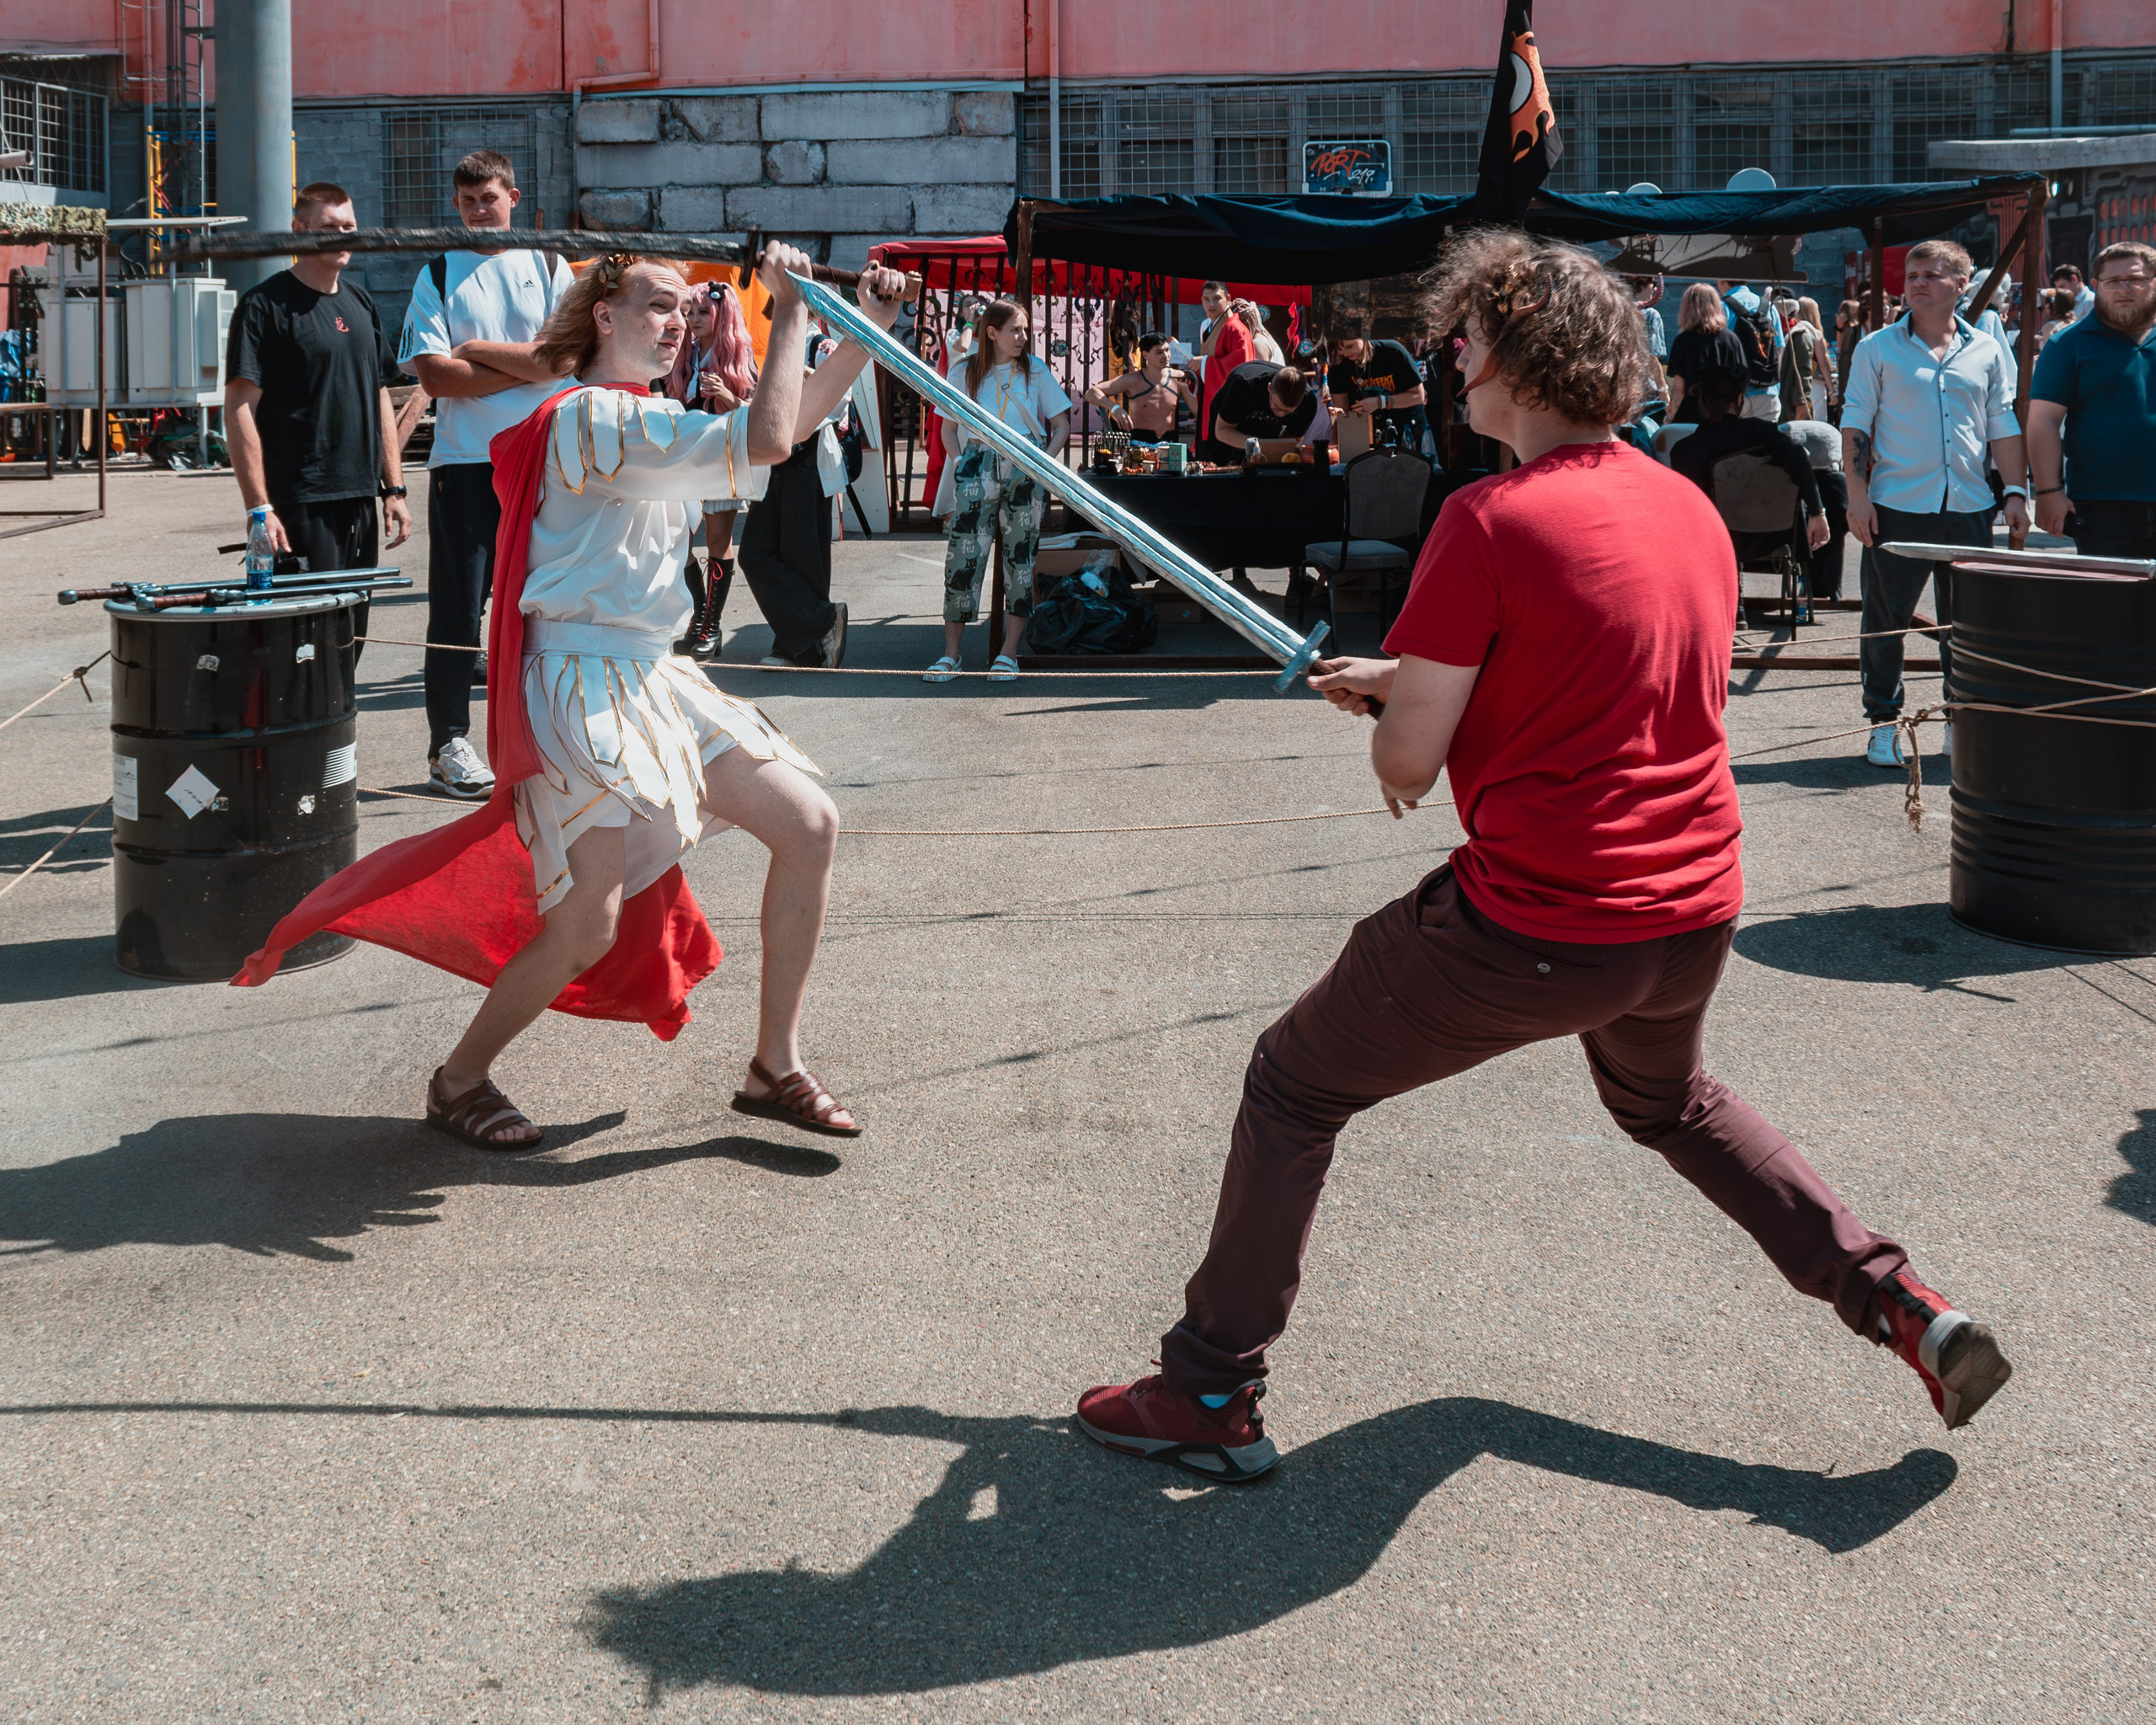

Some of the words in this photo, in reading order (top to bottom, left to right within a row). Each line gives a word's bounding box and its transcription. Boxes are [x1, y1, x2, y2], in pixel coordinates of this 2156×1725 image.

[963, 482, 980, 497] 猫
[960, 538, 976, 554] 猫
[955, 594, 971, 609] 猫
